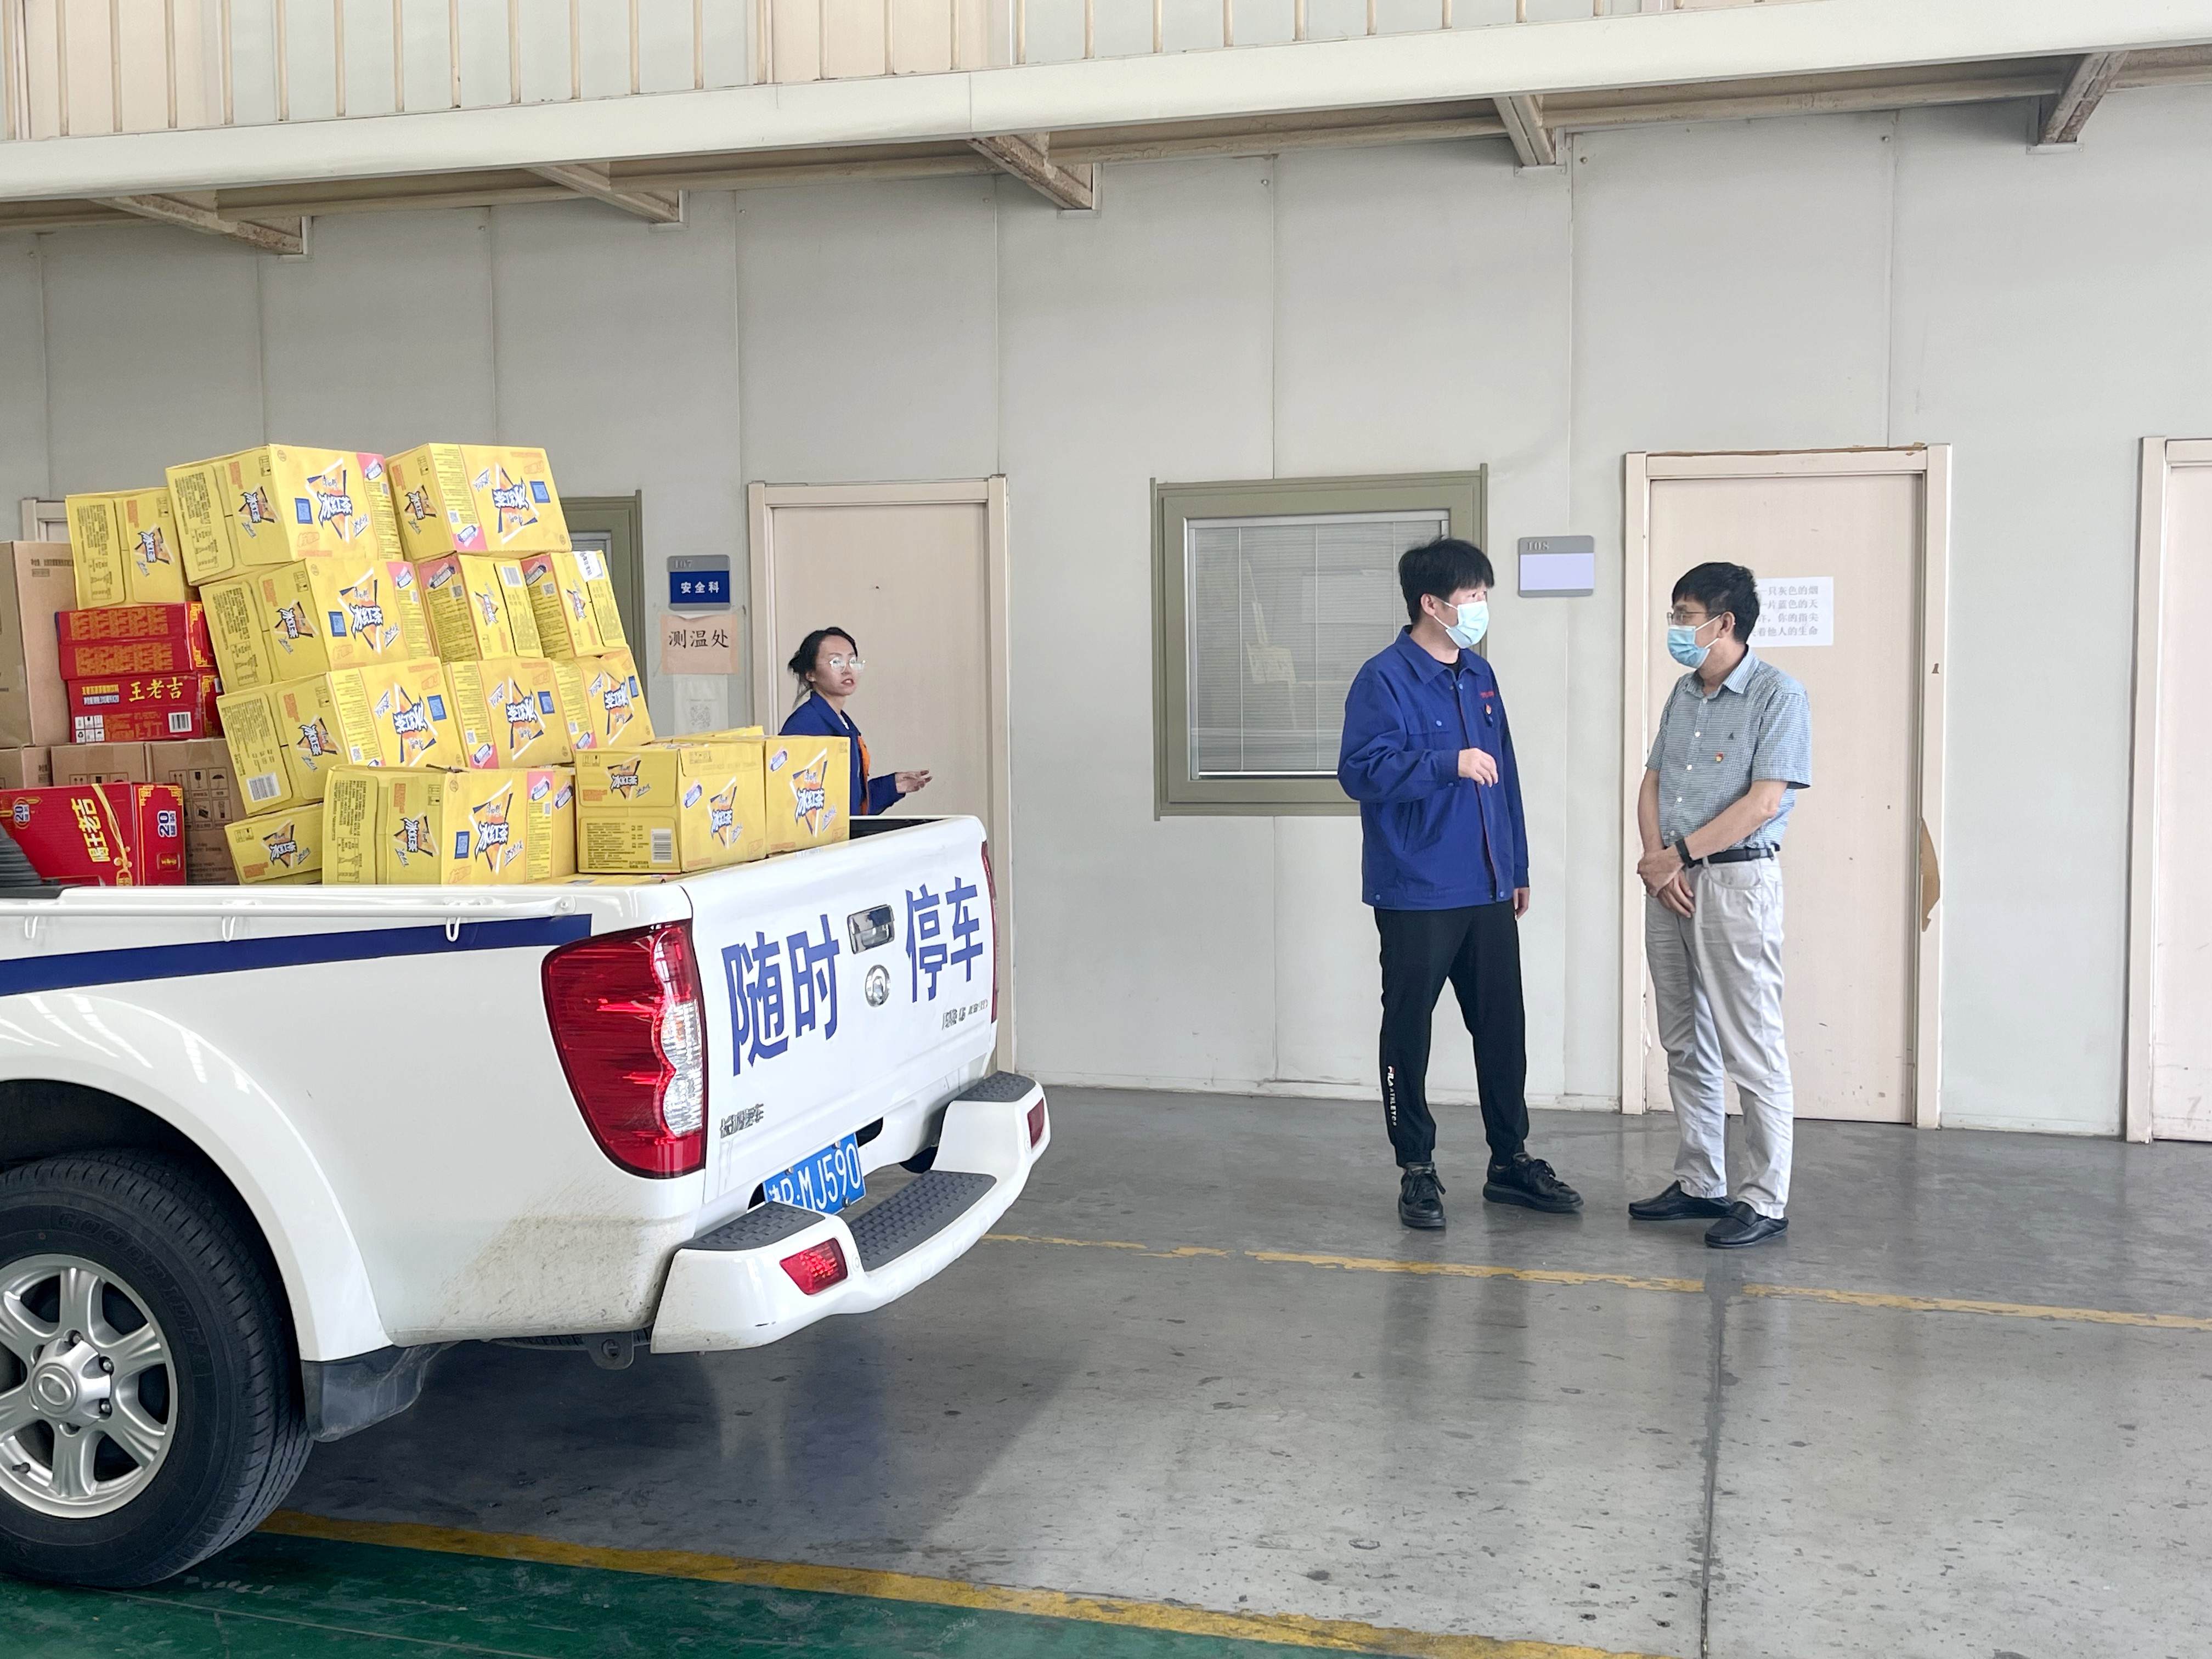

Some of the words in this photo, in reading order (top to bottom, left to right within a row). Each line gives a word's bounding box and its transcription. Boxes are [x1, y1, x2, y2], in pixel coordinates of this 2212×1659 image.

[317, 493, 352, 524] 冰红茶
[493, 482, 529, 509] 冰红茶
[1527, 541, 1549, 551] 108
[675, 560, 693, 569] 107
[680, 581, 720, 594] 安全科
[350, 605, 383, 636] 冰红茶
[1752, 626, 1818, 637] 着他人的生命
[669, 629, 730, 649] 测温处
[128, 676, 184, 702] 王老吉
[393, 697, 427, 733] 冰红茶
[506, 692, 536, 723] 冰红茶
[795, 789, 825, 820] 冰红茶
[71, 798, 111, 862] 喝王老吉
[159, 812, 170, 837] 20
[475, 822, 509, 856] 冰红茶
[721, 914, 840, 1076] 随时
[905, 876, 983, 1003] 停车
